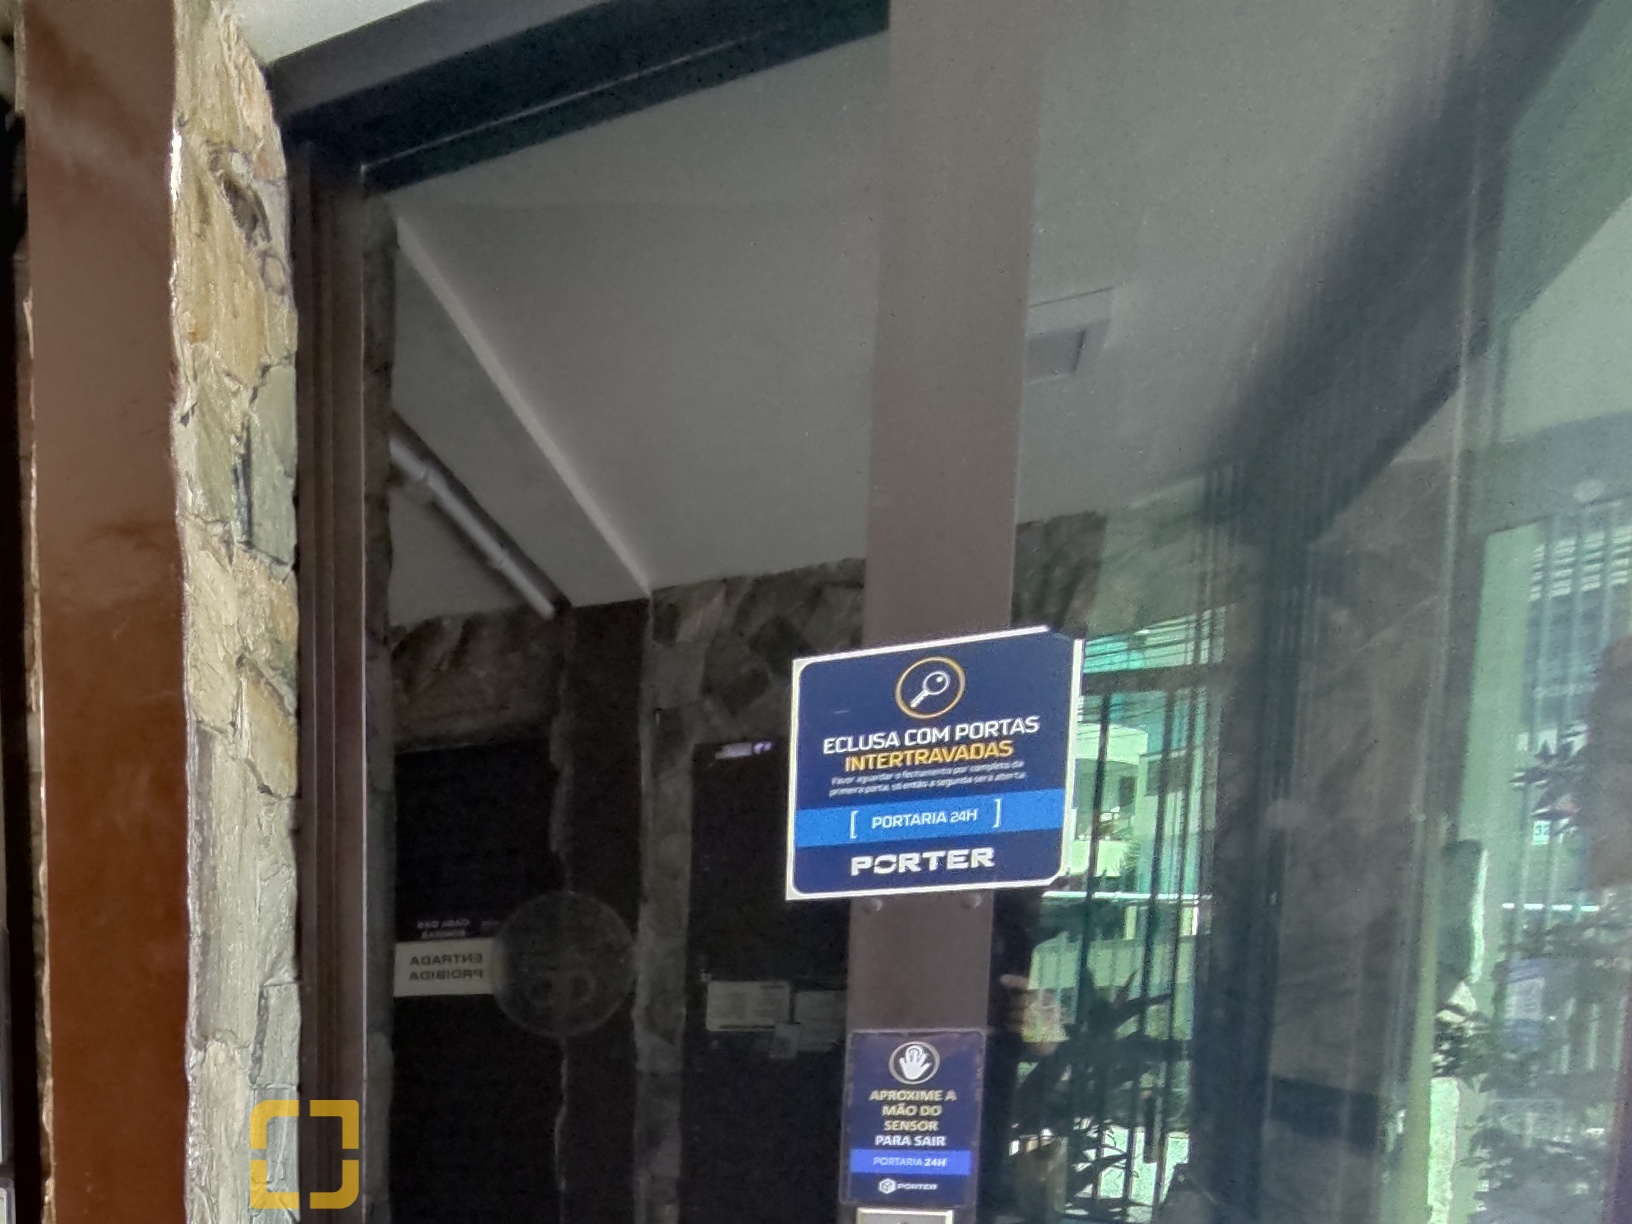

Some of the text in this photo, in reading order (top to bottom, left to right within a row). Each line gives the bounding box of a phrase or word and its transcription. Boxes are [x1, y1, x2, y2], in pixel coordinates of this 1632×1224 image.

[823, 715, 1041, 755] ECLUSA COM PORTAS
[844, 740, 1014, 772] INTERTRAVADAS
[871, 807, 978, 829] PORTARIA 24H
[851, 847, 995, 877] PORTER
[869, 1089, 957, 1102] APROXIME A
[881, 1102, 942, 1116] MÃO DO
[883, 1120, 939, 1131] SENSOR
[875, 1135, 947, 1146] PARA SAIR
[873, 1156, 948, 1167] PORTARIA 24H
